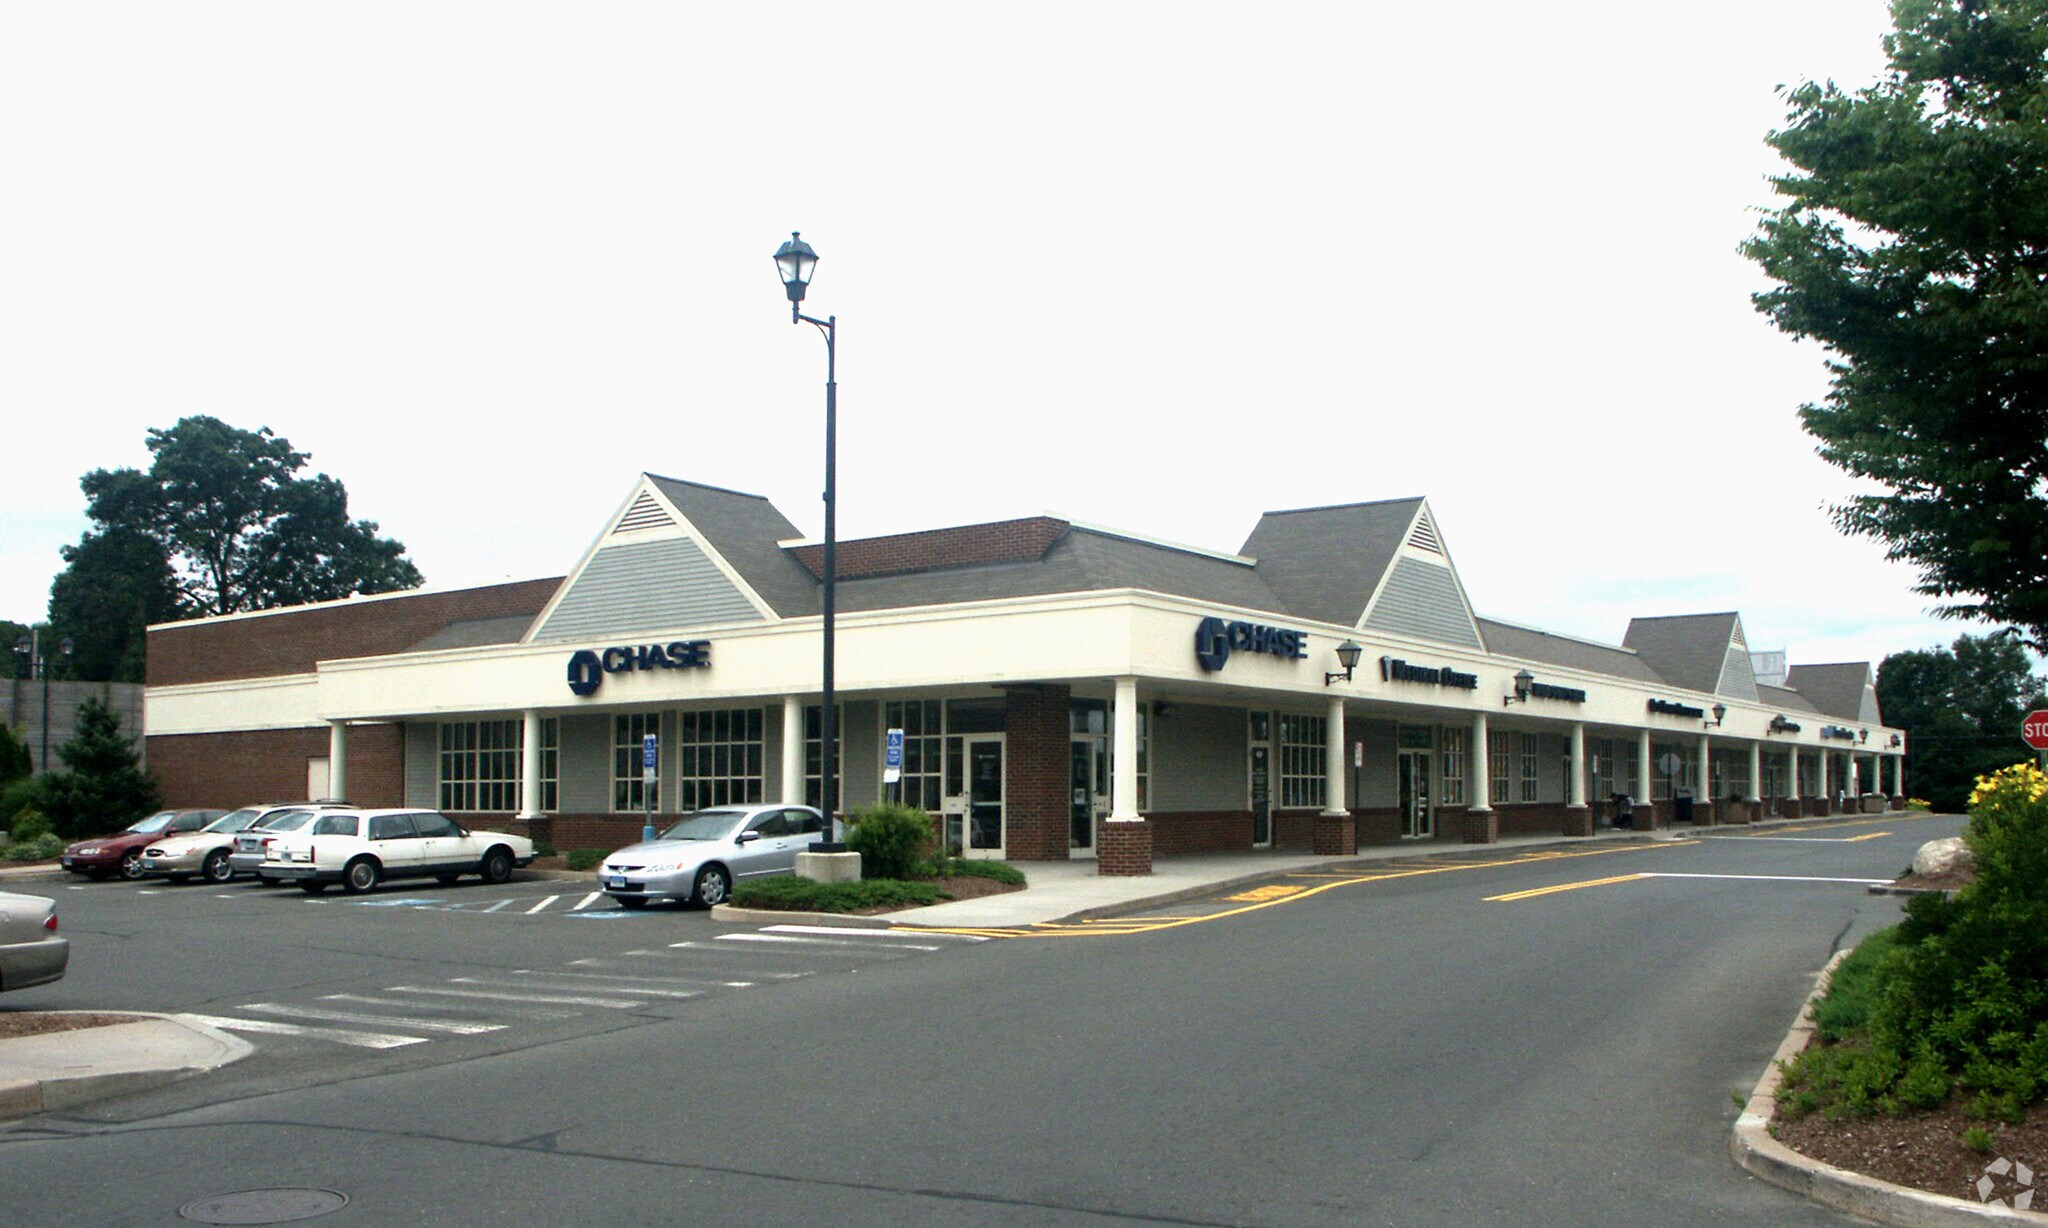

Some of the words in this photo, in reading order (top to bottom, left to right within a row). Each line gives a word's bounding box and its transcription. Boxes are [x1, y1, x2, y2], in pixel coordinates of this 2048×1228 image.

[602, 640, 711, 673] CHASE
[1227, 621, 1308, 659] CHASE
[2025, 723, 2048, 737] STO
